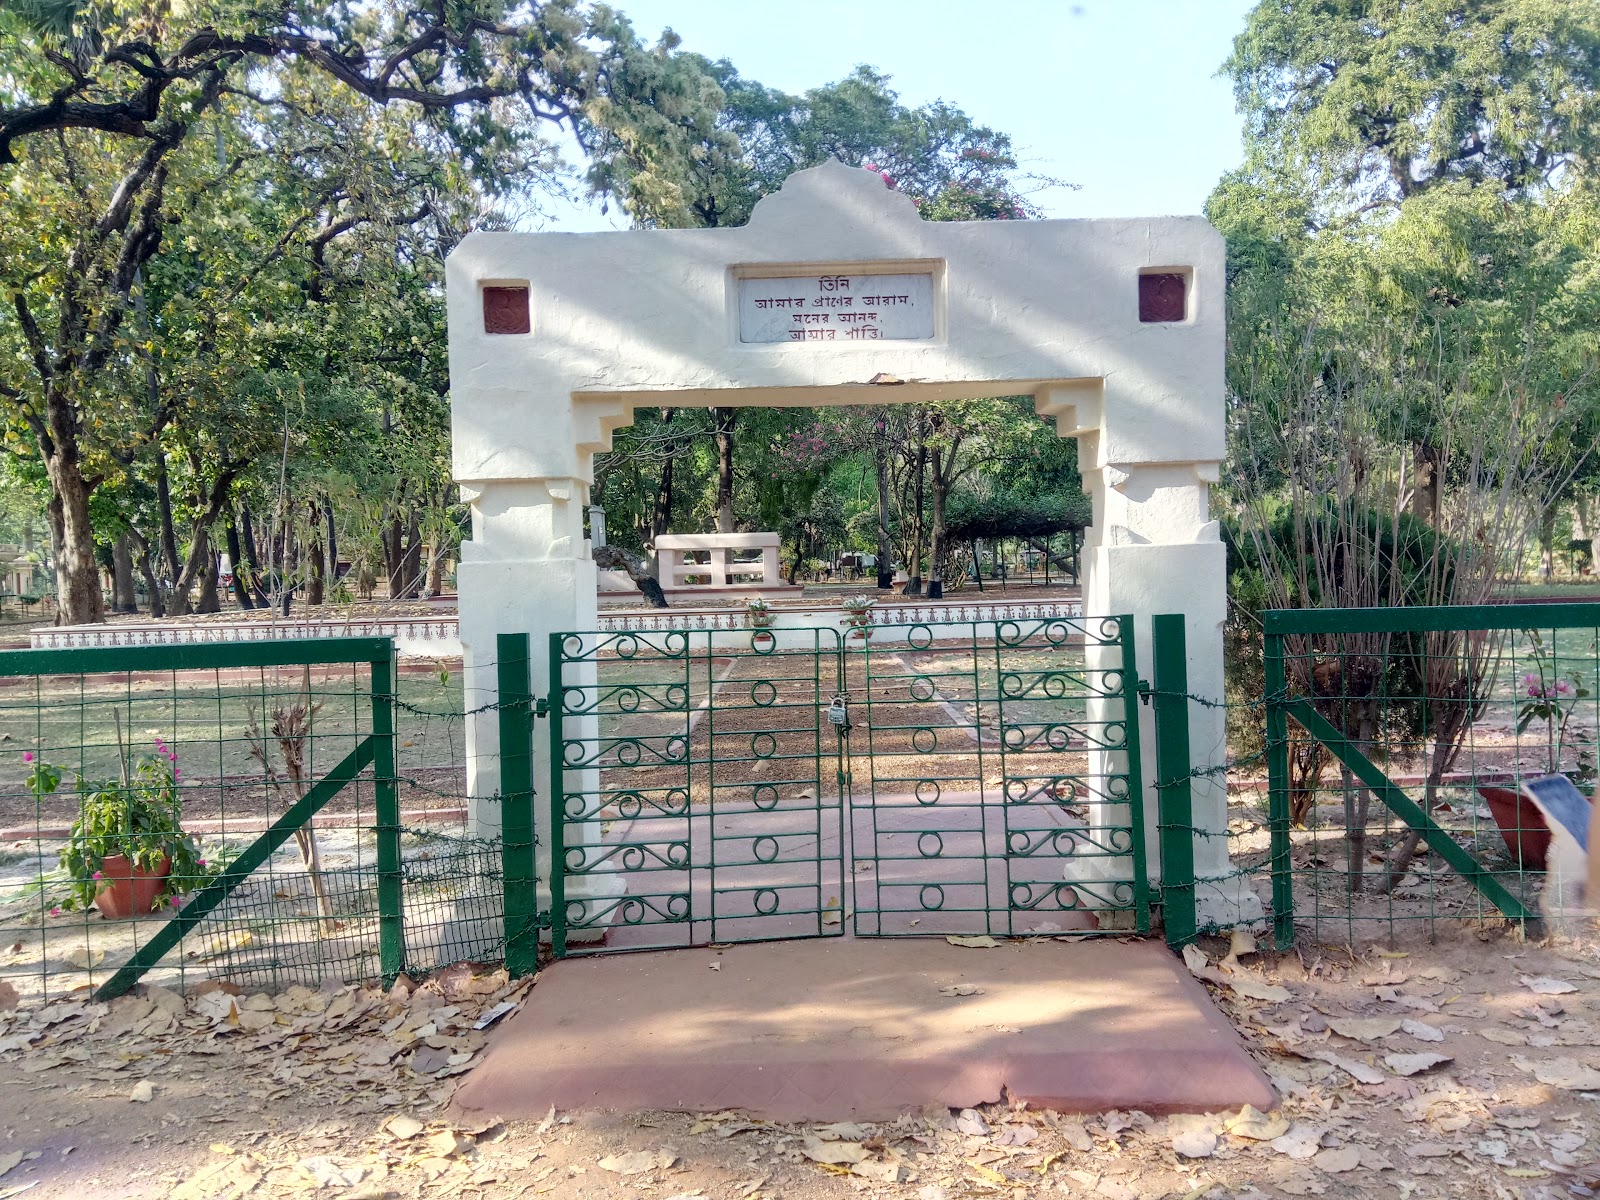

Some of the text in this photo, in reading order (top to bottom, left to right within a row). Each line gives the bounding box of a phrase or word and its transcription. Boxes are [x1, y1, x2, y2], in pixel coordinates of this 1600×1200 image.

[819, 275, 850, 292] তিনি
[755, 295, 915, 309] আমার প্রাণের আরাম,
[792, 313, 830, 324] মনের
[789, 328, 836, 341] আমার
